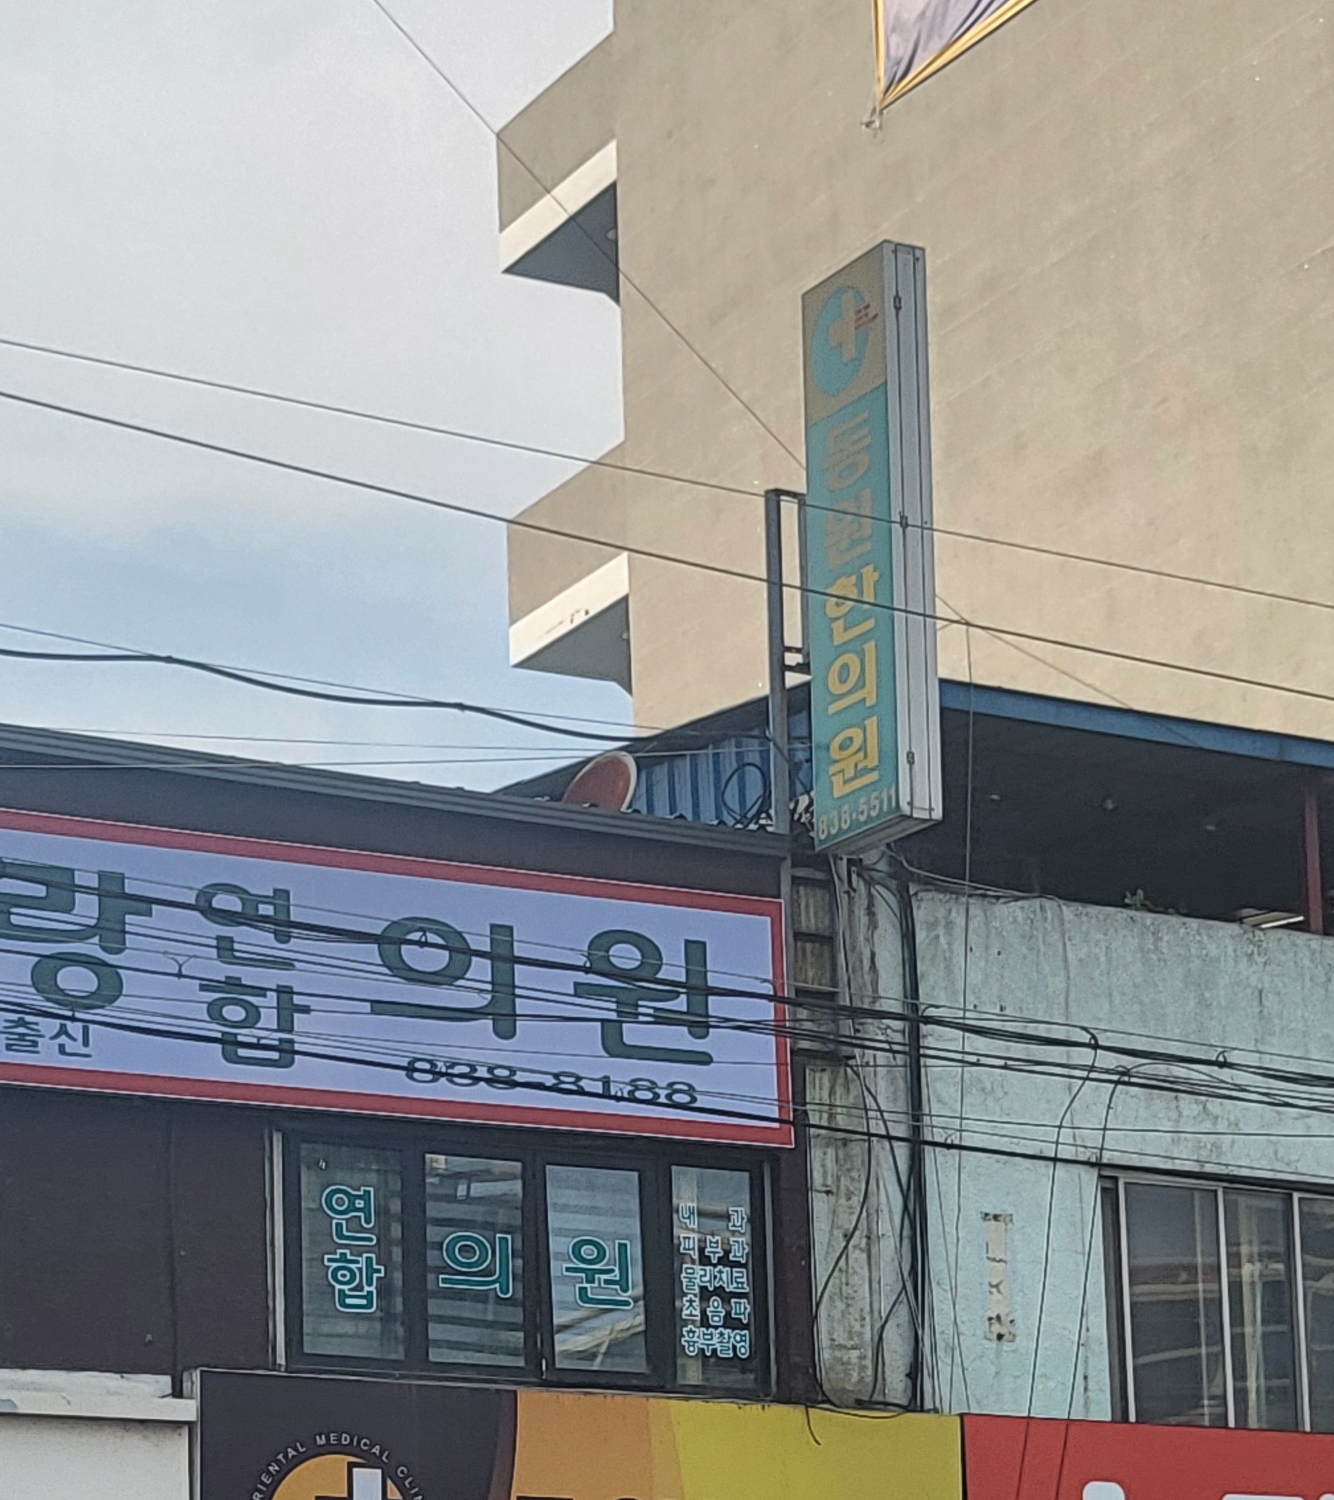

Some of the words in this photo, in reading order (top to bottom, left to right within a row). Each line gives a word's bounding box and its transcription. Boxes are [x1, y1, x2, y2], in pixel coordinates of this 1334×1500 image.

[370, 916, 715, 1067] 의원
[1, 1014, 94, 1060] 출신
[681, 1263, 750, 1293] 물리치료
[682, 1325, 750, 1359] 흉부촬영
[315, 1432, 390, 1463] MEDICAL
